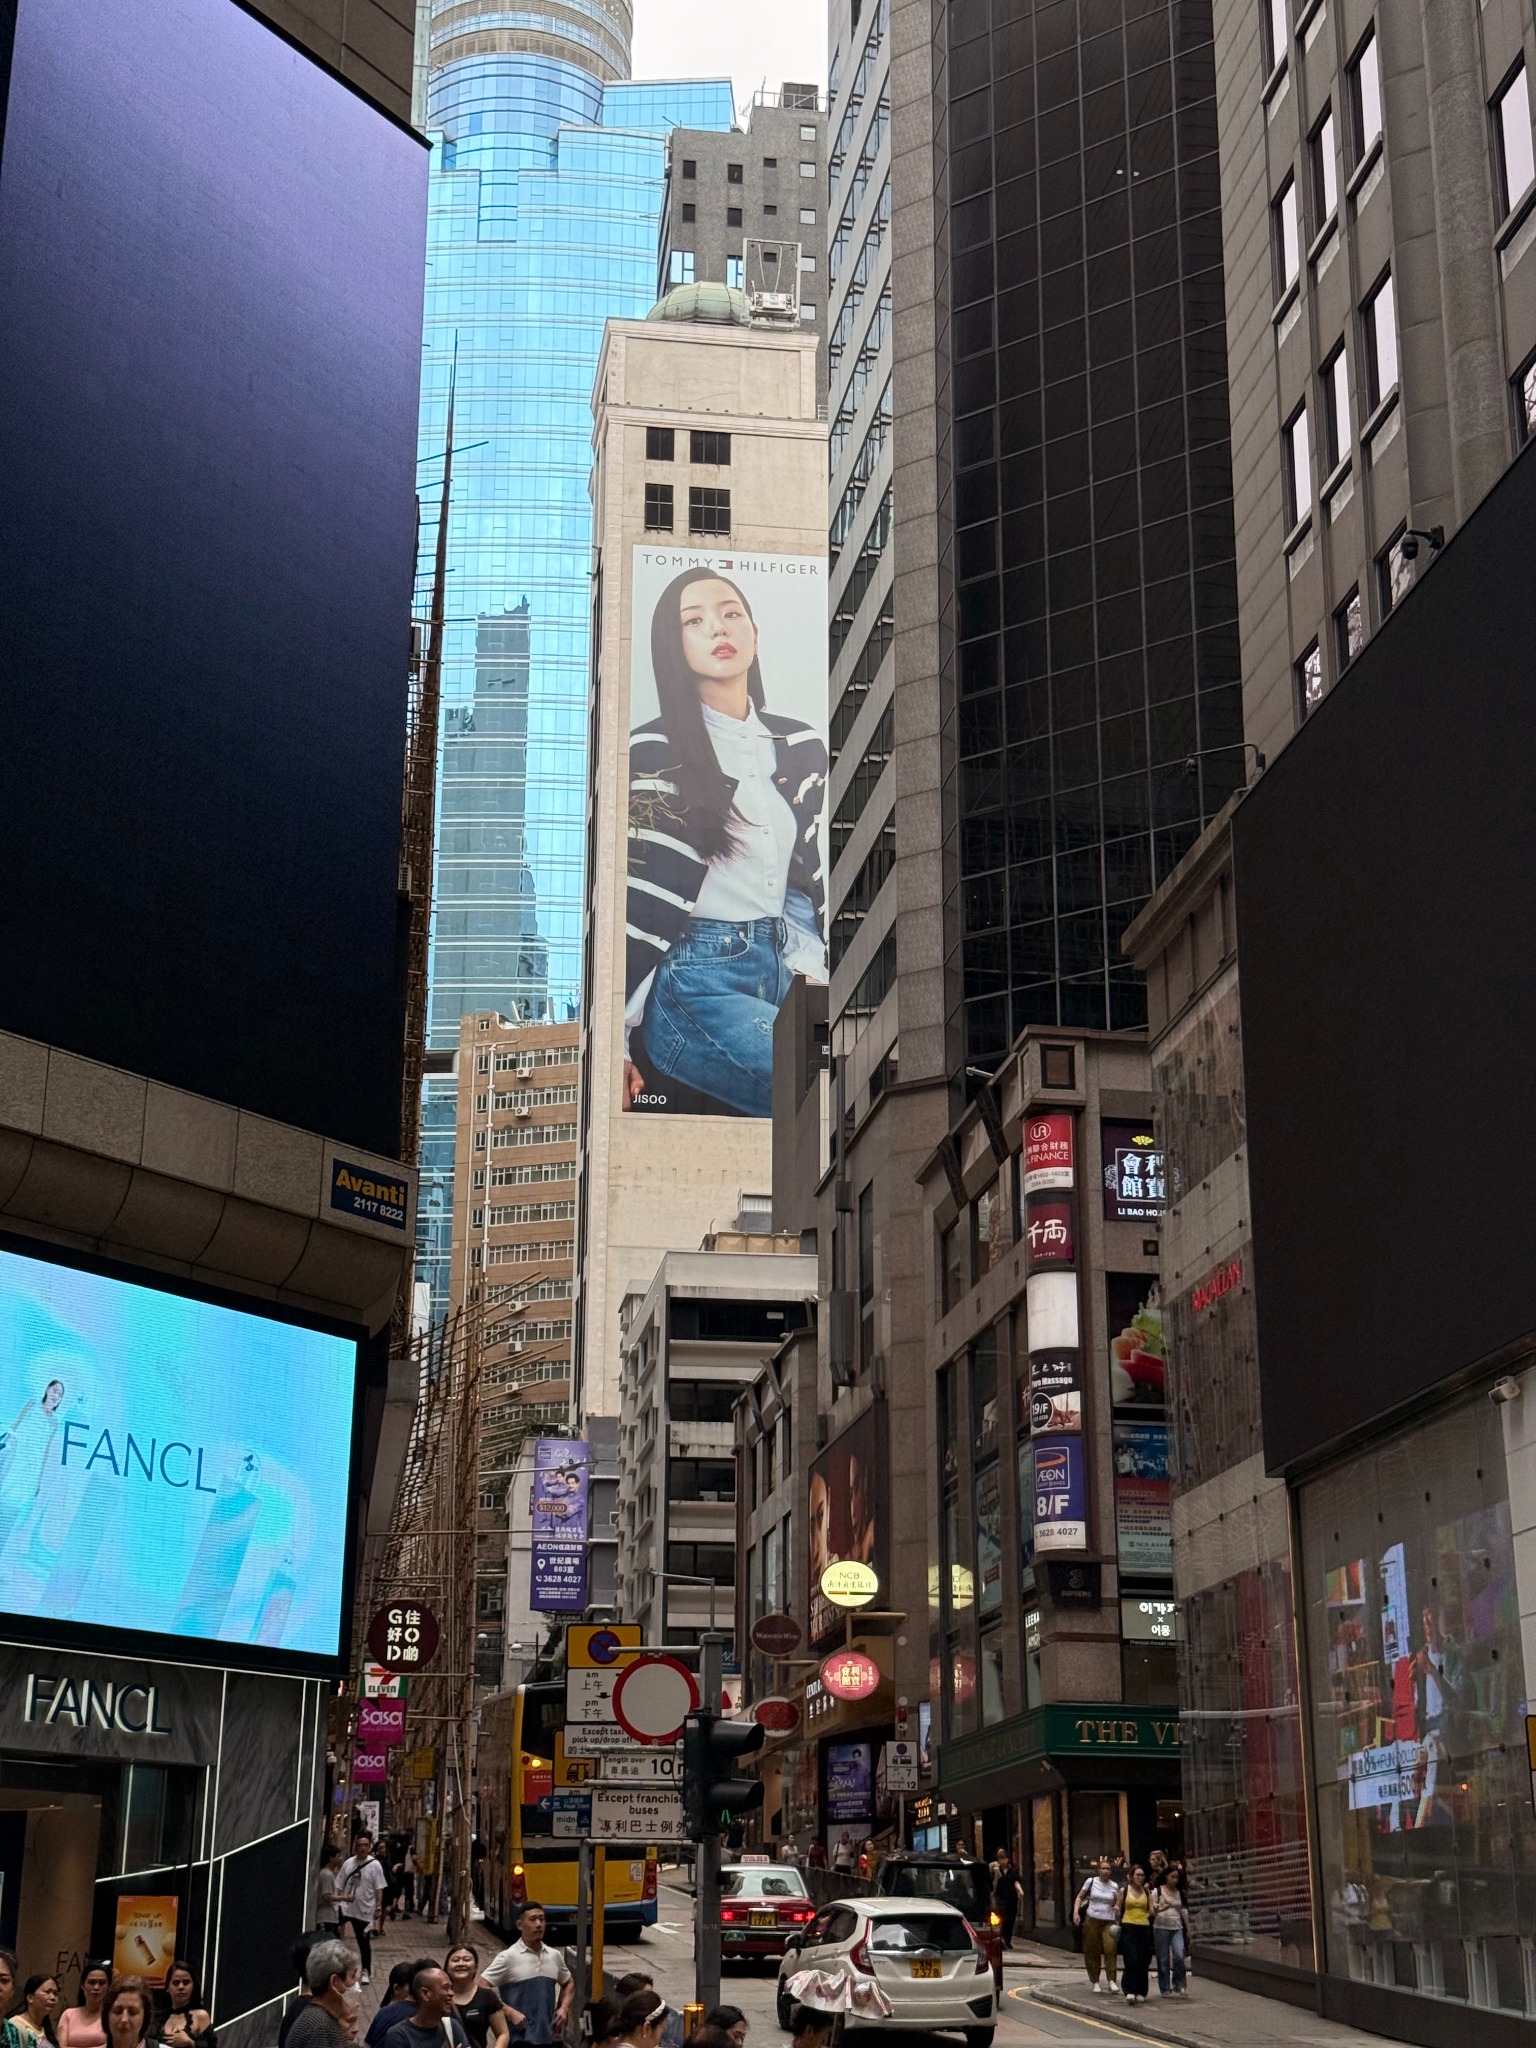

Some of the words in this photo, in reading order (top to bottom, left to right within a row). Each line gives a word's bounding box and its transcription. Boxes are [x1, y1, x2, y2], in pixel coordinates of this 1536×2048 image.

[643, 554, 713, 568] TOMMY
[740, 561, 818, 575] HILFIGER
[633, 1094, 667, 1105] JISOO
[1030, 1151, 1069, 1164] FINANCE
[336, 1169, 404, 1206] Avanti
[354, 1197, 378, 1213] 2117
[380, 1205, 404, 1221] 8222
[1117, 1207, 1126, 1215] LI
[1127, 1208, 1144, 1216] BAO
[61, 1420, 218, 1494] FANCL
[1037, 1495, 1070, 1516] 8/F
[1057, 1528, 1078, 1536] 4027
[549, 1557, 580, 1565] 世紀廣場
[543, 1575, 562, 1583] 3628
[839, 1572, 860, 1580] NCB
[368, 1685, 396, 1694] ELEVEN
[581, 1680, 603, 1690] 上午
[24, 1673, 172, 1735] FANCL
[581, 1709, 602, 1719] 下午
[582, 1727, 609, 1737] Except
[1075, 1720, 1139, 1744] THE
[572, 1736, 588, 1745] pick
[590, 1736, 620, 1745] up/drop
[621, 1736, 633, 1744] off
[605, 1756, 628, 1765] Length
[652, 1758, 673, 1776] 10
[611, 1766, 640, 1776] 車長逾
[906, 1769, 912, 1777] 7
[907, 1781, 917, 1789] 12
[598, 1793, 633, 1804] Except
[629, 1804, 659, 1814] buses
